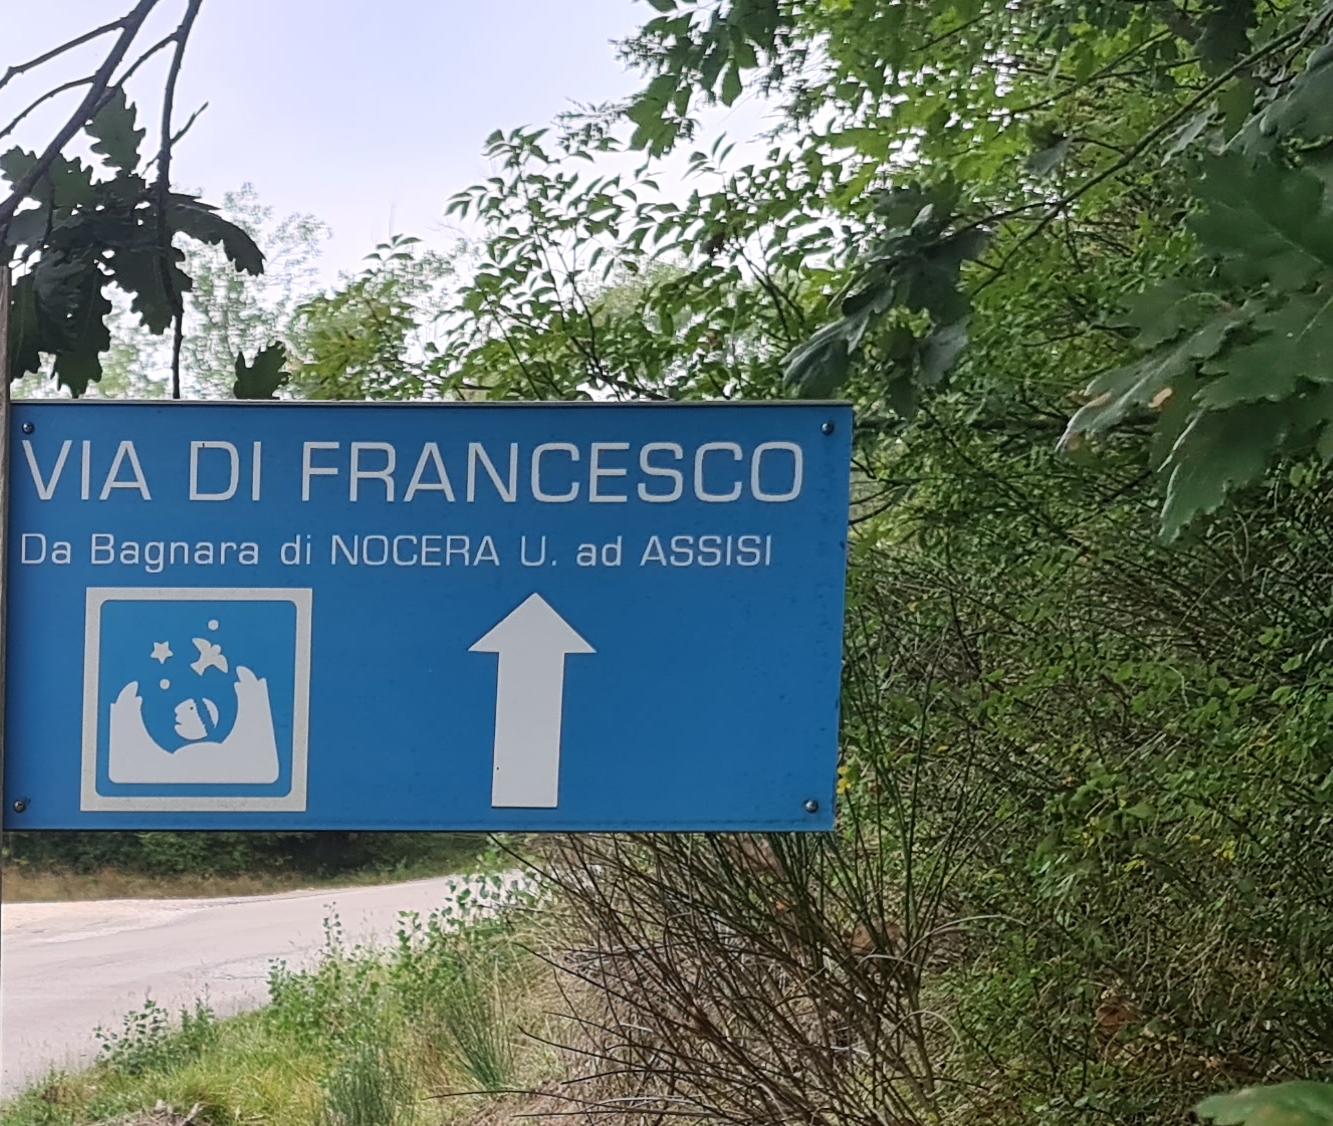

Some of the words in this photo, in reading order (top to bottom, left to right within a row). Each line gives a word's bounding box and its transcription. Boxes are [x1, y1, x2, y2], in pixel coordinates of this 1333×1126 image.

[21, 440, 152, 500] VIA
[189, 441, 262, 501] DI
[301, 441, 804, 503] FRANCESCO
[21, 533, 72, 564] Da
[91, 533, 259, 573] Bagnara
[280, 534, 311, 565] di
[331, 535, 500, 566] NOCERA
[520, 535, 558, 567] U.
[576, 535, 623, 567] ad
[639, 535, 772, 567] ASSISI
